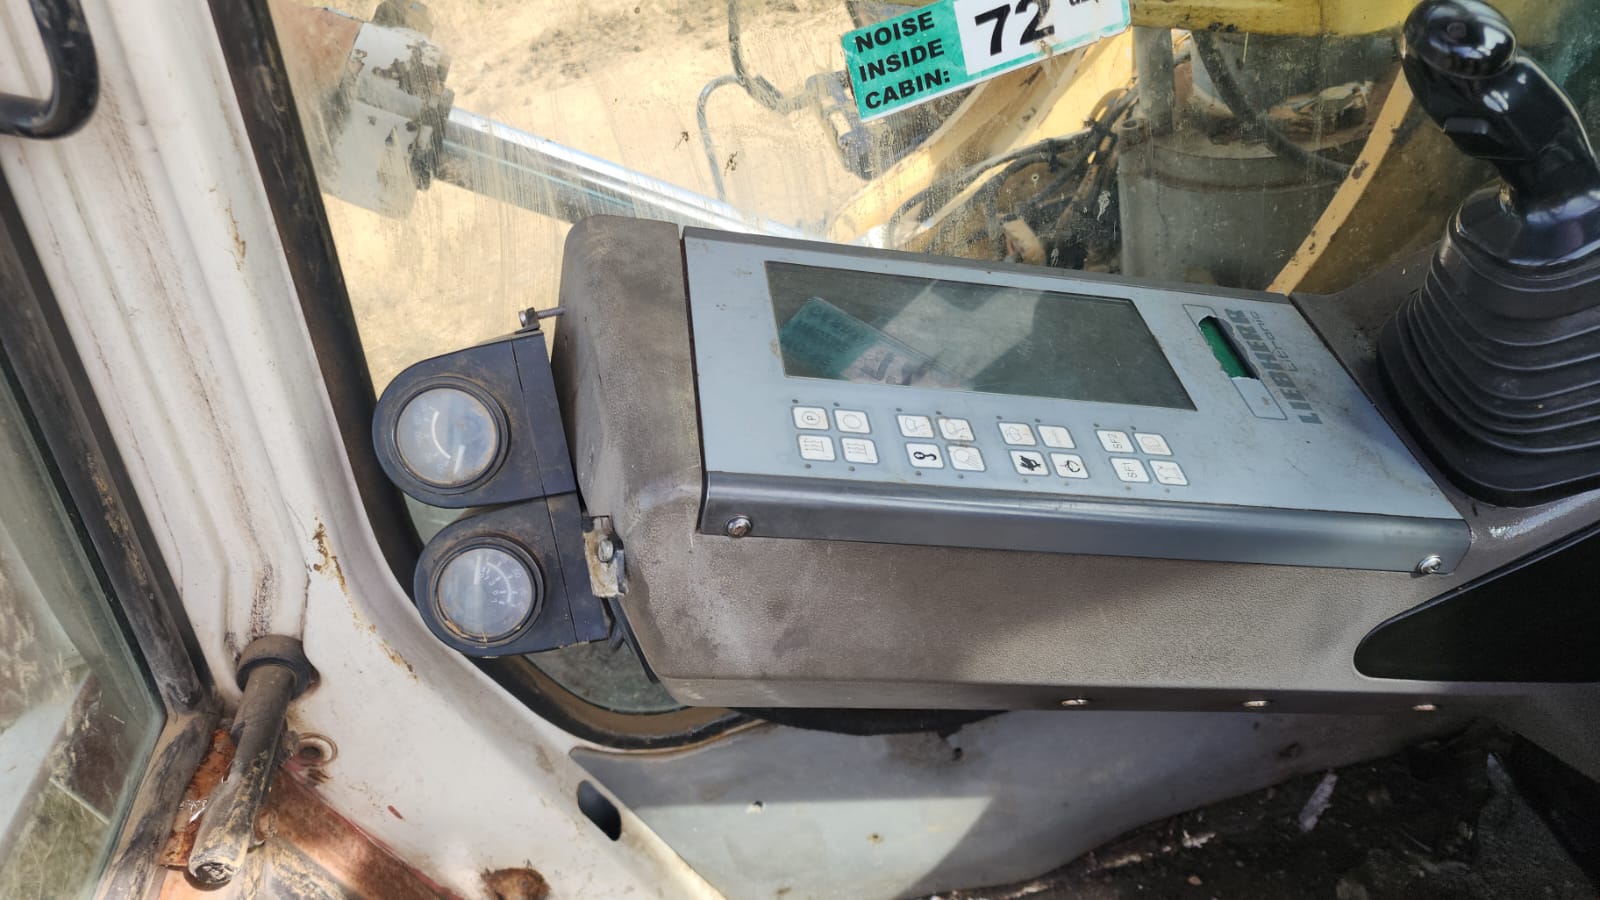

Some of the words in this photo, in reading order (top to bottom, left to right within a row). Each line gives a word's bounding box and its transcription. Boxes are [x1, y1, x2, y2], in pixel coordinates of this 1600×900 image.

[854, 11, 936, 54] NOISE
[974, 0, 1055, 57] 72
[858, 38, 945, 83] INSIDE
[864, 70, 951, 110] CABIN:
[1224, 308, 1323, 425] LIEBHERR
